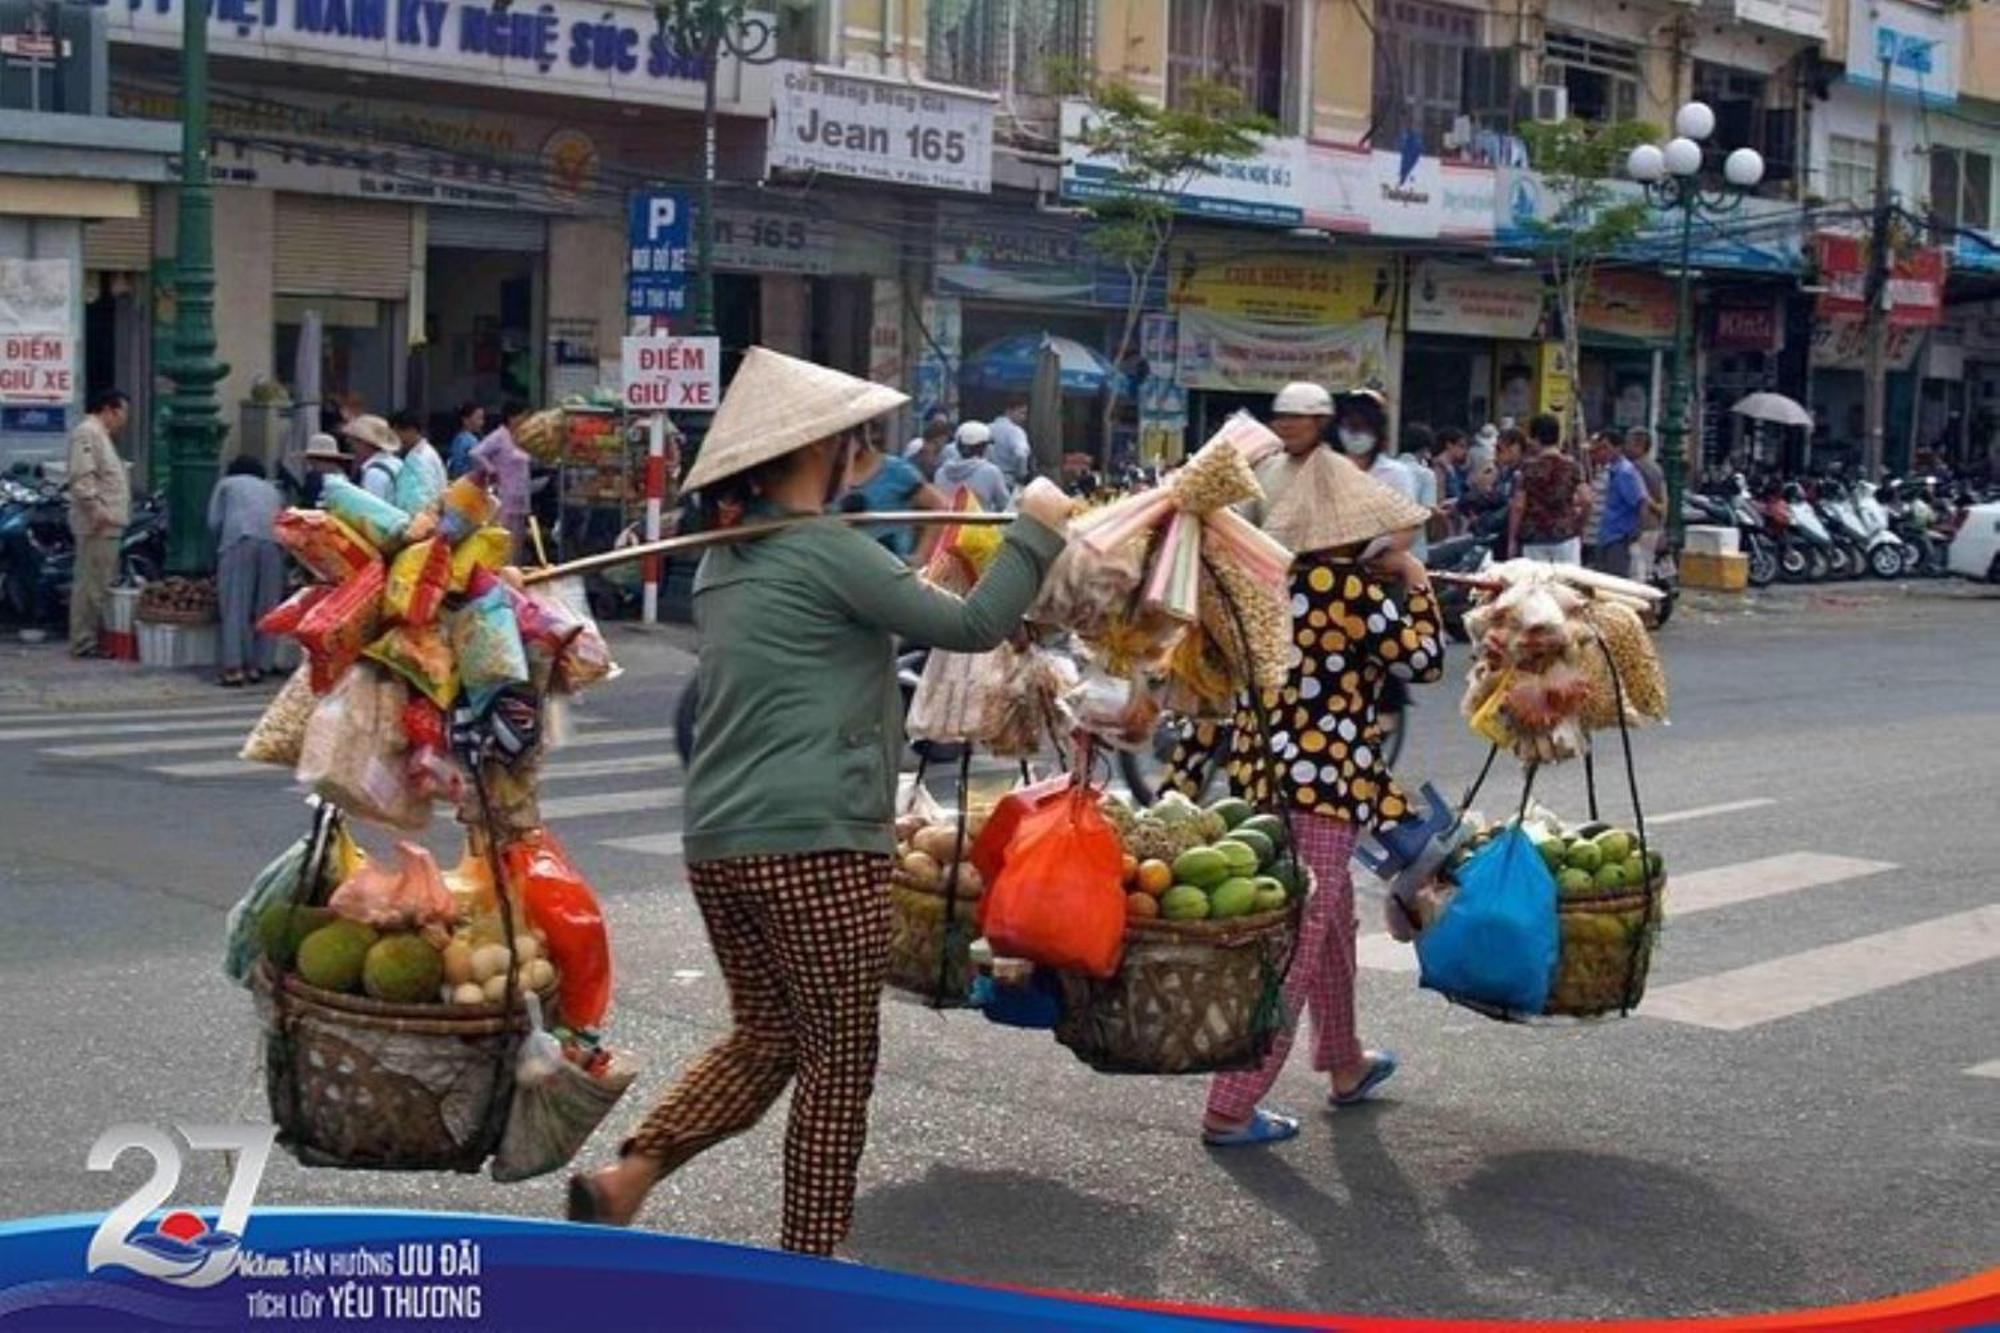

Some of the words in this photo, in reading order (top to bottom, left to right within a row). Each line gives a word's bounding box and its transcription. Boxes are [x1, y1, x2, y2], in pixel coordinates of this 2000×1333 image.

[796, 108, 889, 155] Jean
[906, 123, 966, 164] 165
[649, 197, 676, 240] P
[6, 332, 63, 361] ĐIỂM
[639, 339, 705, 371] ĐIỂM
[0, 363, 35, 390] GIỮ
[43, 370, 71, 390] XE
[629, 375, 669, 404] GIỮ
[681, 383, 712, 404] XE
